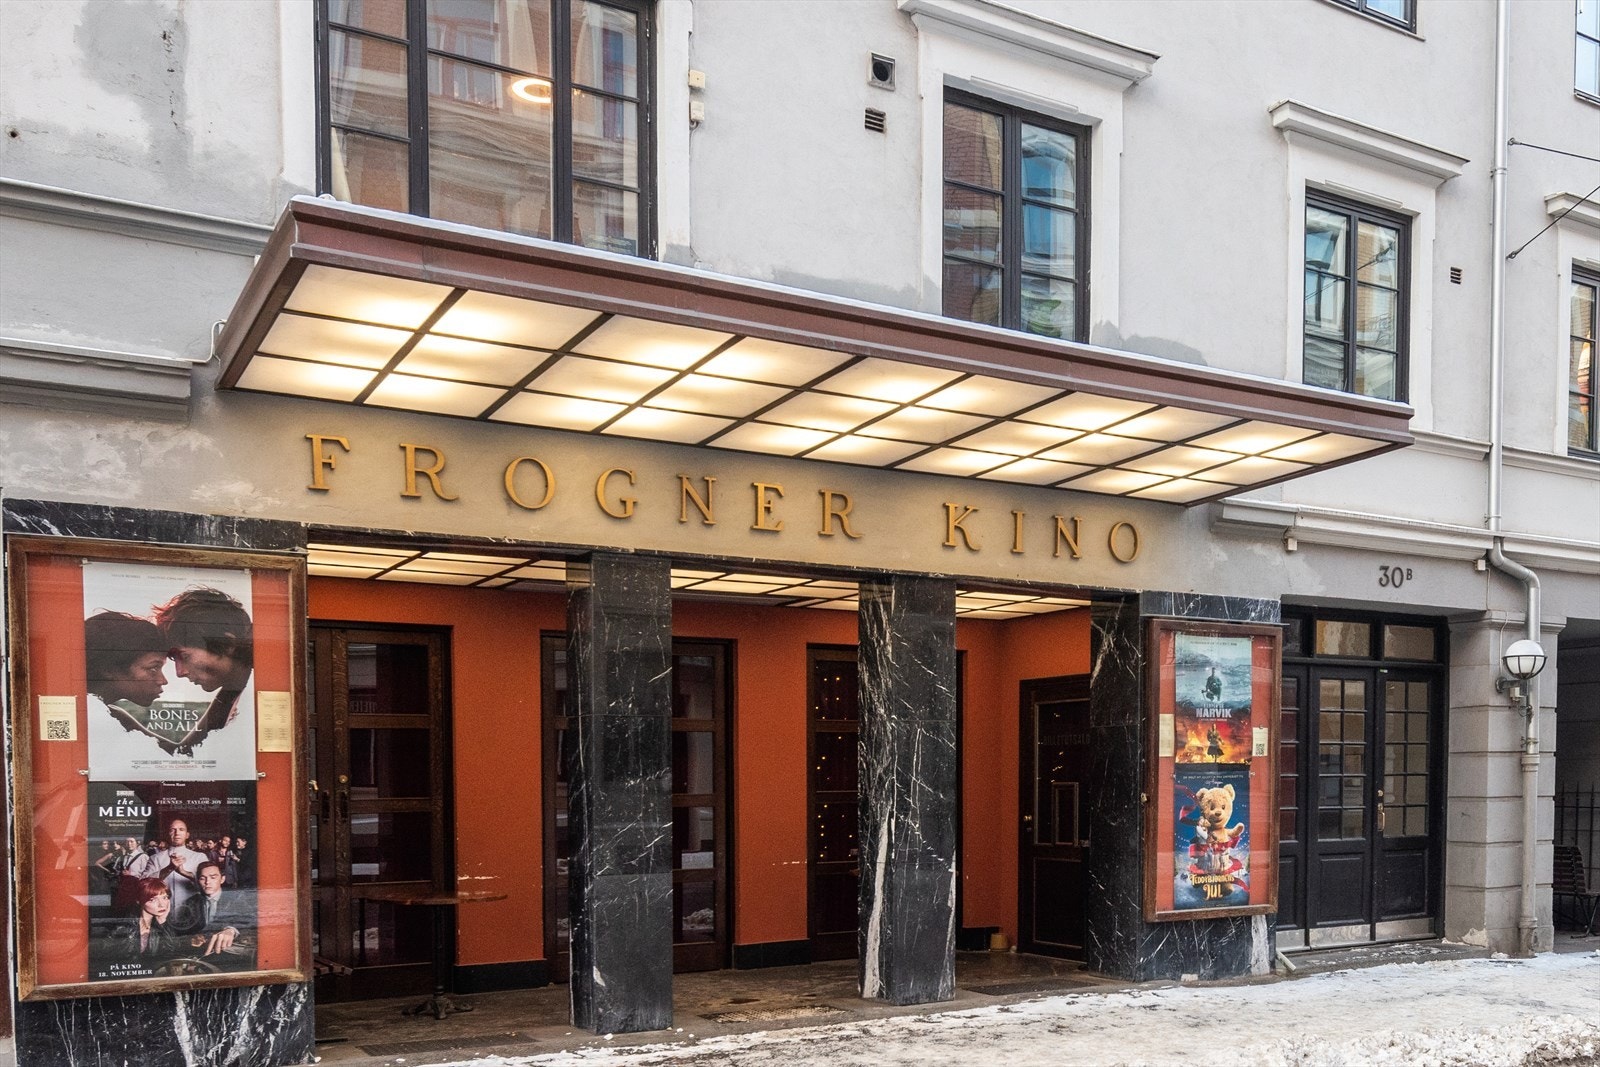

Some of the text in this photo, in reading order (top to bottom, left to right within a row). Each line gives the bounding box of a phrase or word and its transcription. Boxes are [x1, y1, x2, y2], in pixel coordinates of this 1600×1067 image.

[306, 433, 1141, 564] FROGNER KINO
[1379, 565, 1413, 588] 30B
[150, 709, 199, 720] BONES
[1195, 707, 1232, 718] NARVIK
[146, 721, 202, 732] AND ALL
[117, 797, 134, 805] the
[98, 806, 152, 817] MENU
[1203, 883, 1223, 901] JUL
